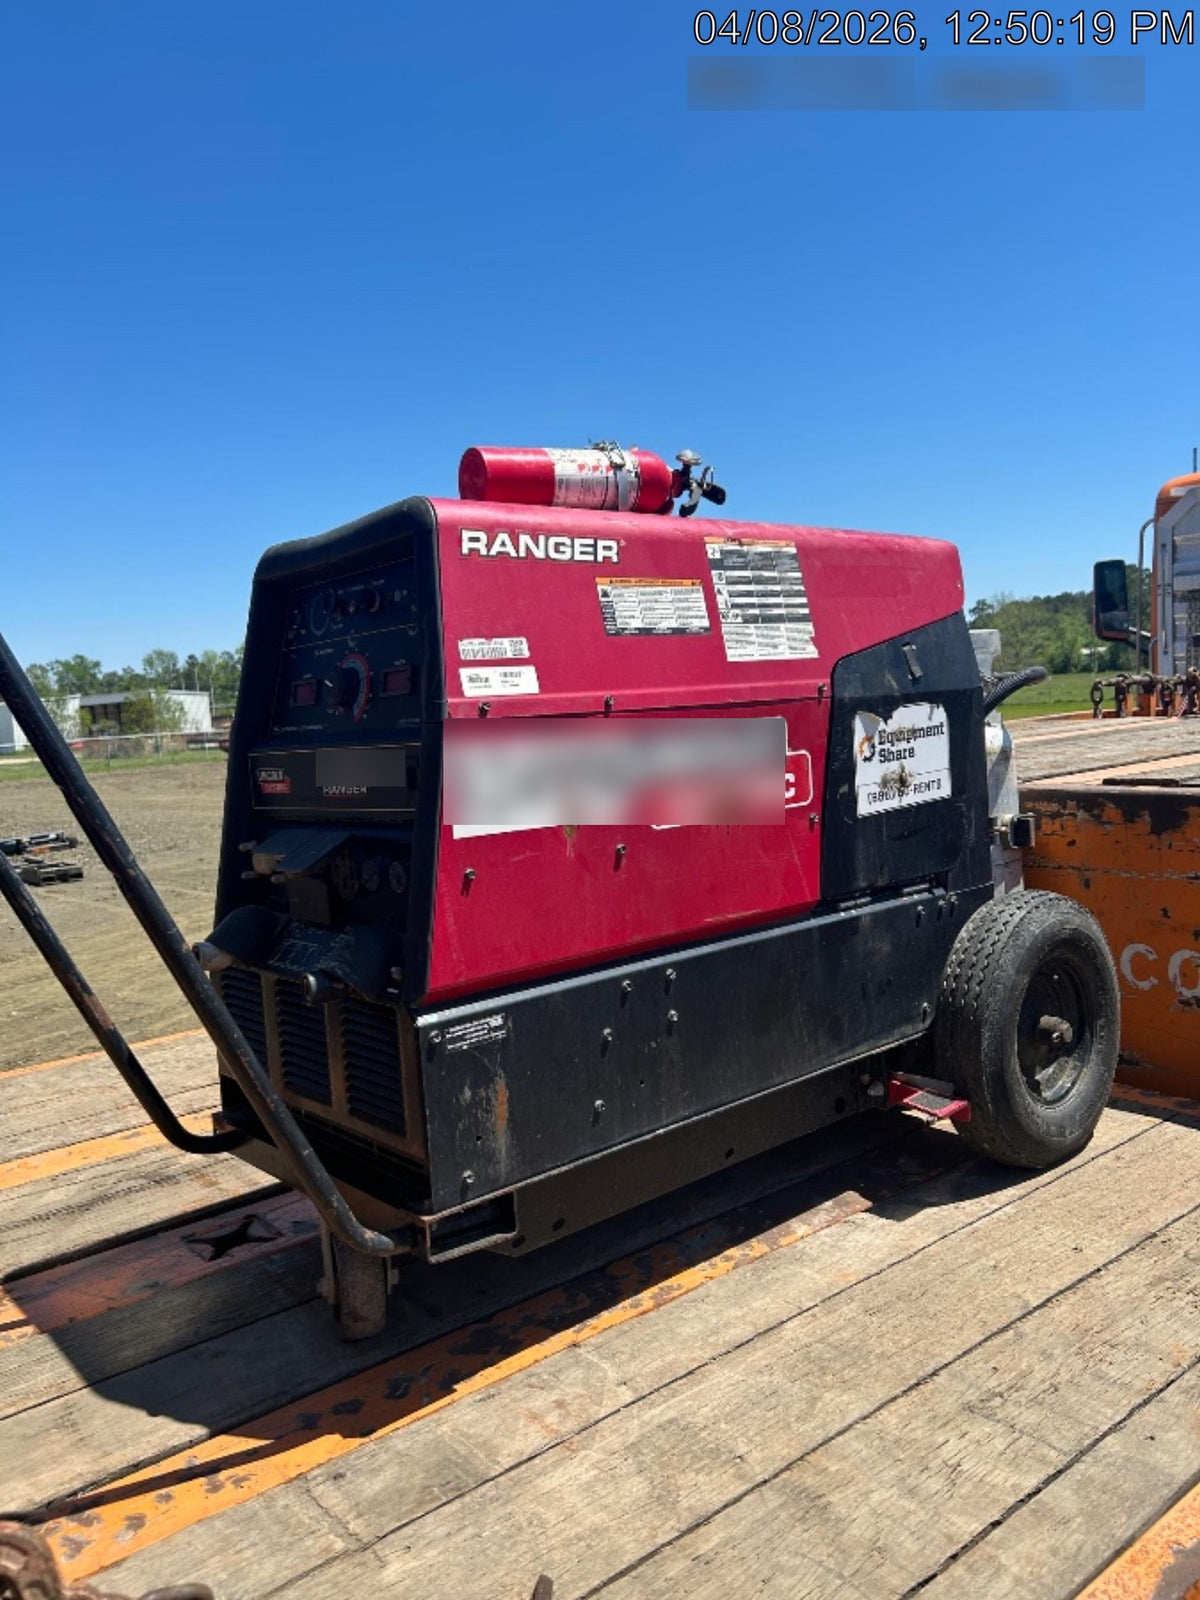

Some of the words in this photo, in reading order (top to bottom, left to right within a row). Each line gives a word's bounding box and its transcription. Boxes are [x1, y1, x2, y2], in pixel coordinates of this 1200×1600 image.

[461, 528, 619, 563] RANGER
[878, 721, 944, 747] Equipment
[879, 746, 915, 763] Share
